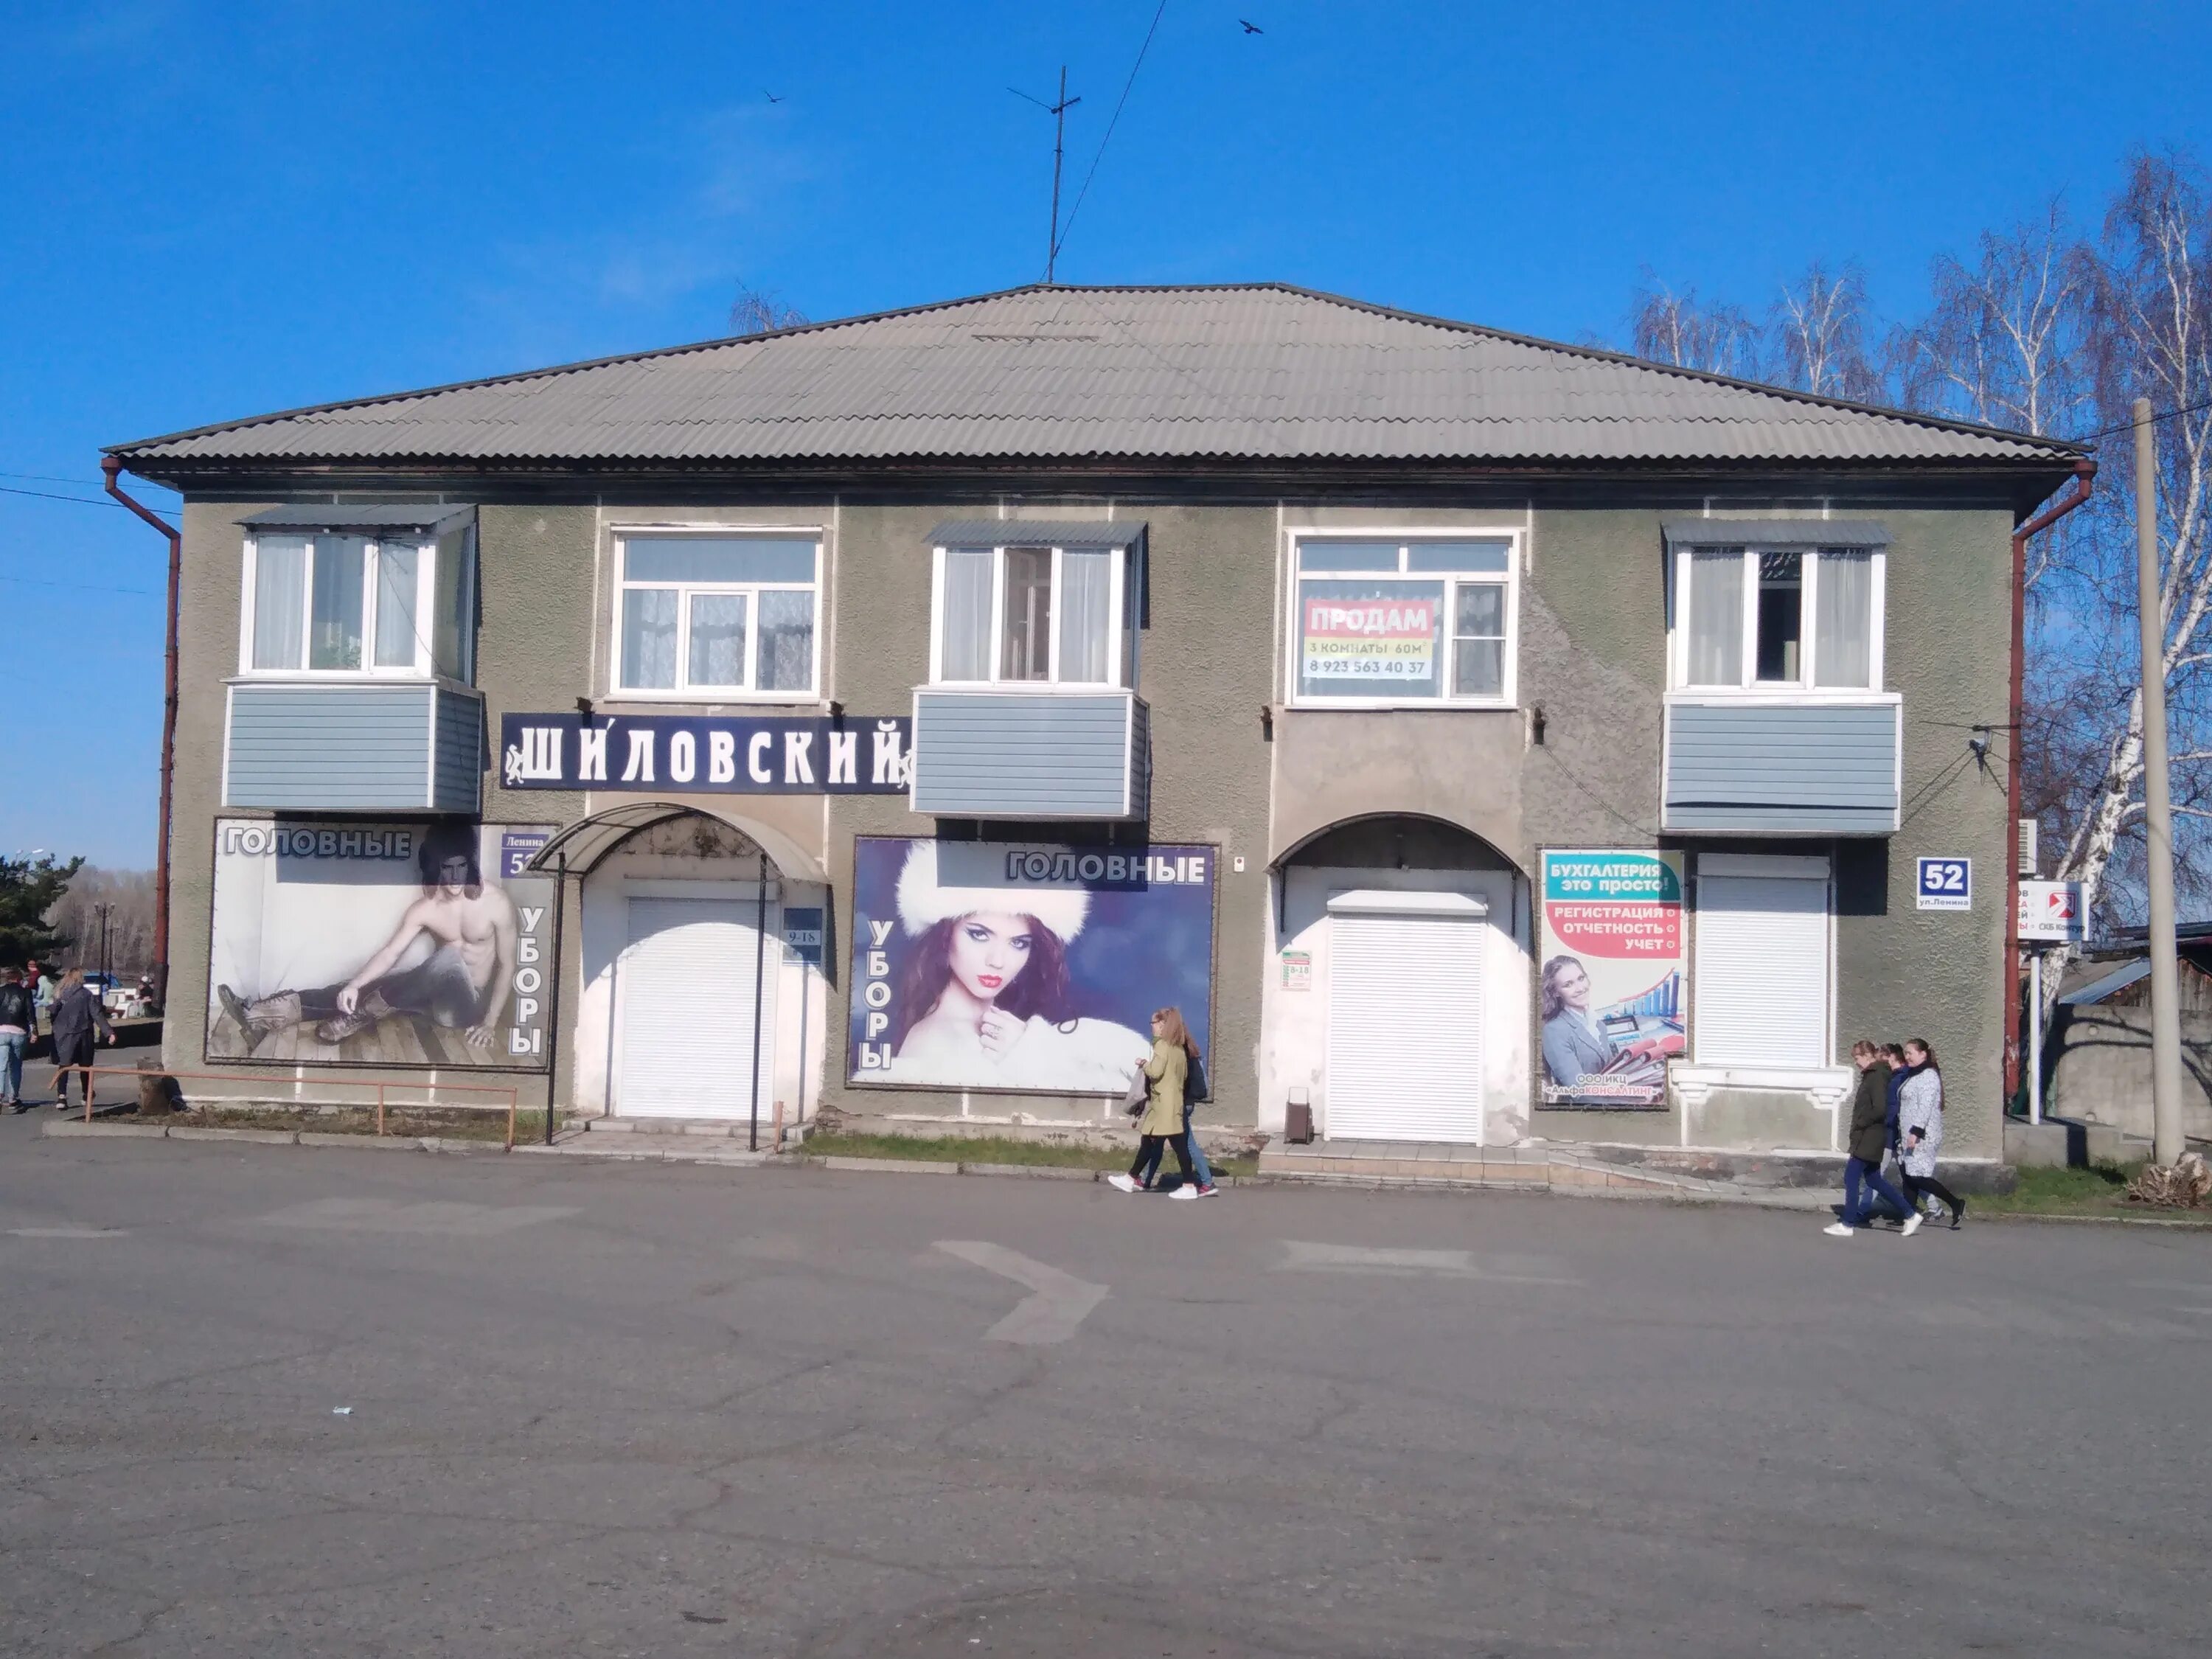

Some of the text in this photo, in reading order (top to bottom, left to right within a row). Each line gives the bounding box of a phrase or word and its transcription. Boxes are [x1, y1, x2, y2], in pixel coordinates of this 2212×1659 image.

[1311, 608, 1428, 635] ПРОДАМ
[1310, 643, 1317, 653] 3
[1321, 643, 1387, 653] КОМНАТЫ
[1310, 660, 1425, 673] 8 923 563 40 37
[225, 827, 411, 859] ГОЛОВНЫЕ
[507, 836, 544, 846] Ленина
[1006, 850, 1205, 884] ГОЛОВНЫЕ
[1551, 864, 1661, 877] БУХГАЛТЕРИЯ
[1925, 863, 1963, 890] 52
[1554, 907, 1663, 919] РЕГИСТРАЦИЯ
[1563, 923, 1663, 934] ОТЧЕТНОСТЬ
[2056, 923, 2085, 933] Контур
[790, 932, 815, 942] 9-18
[1625, 939, 1664, 950] УЧЕТ
[509, 906, 546, 1056] УБОРЫ
[859, 919, 894, 1069] УБОРЫ
[1605, 1075, 1627, 1085] ИКЦ
